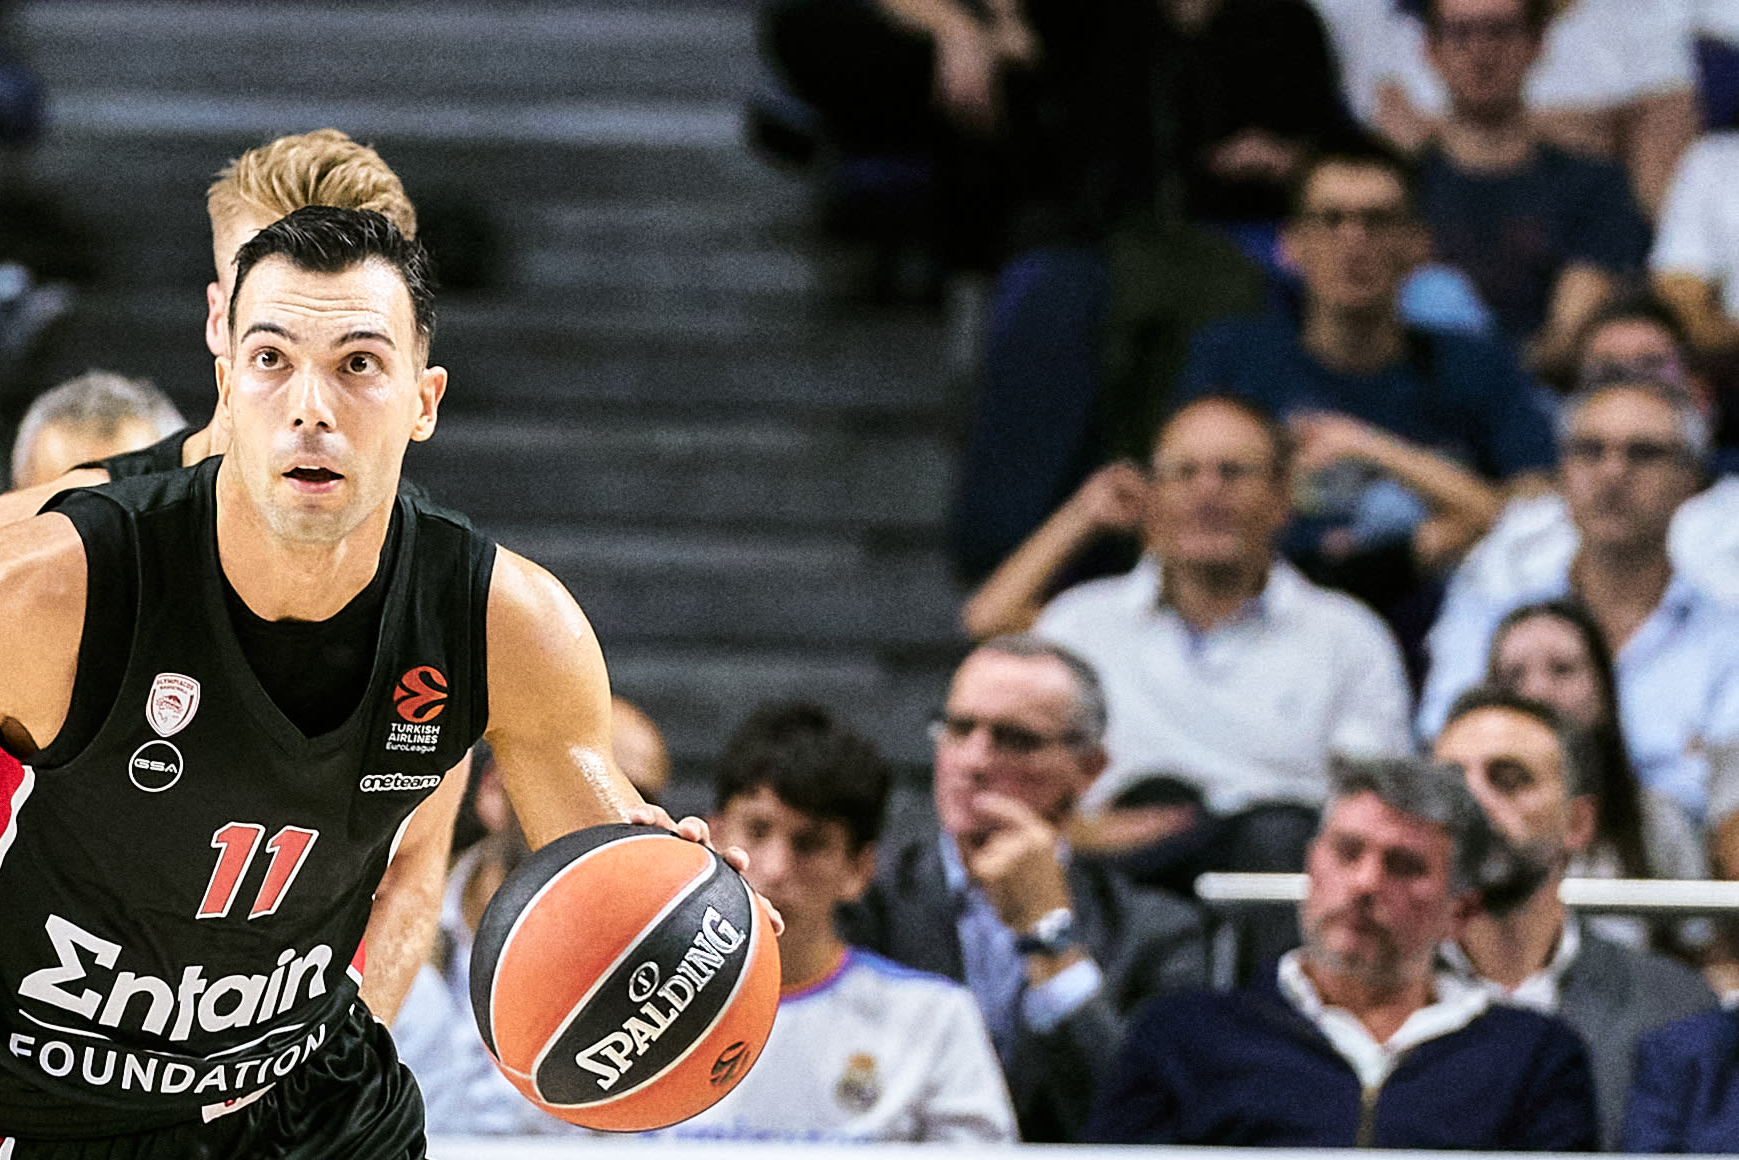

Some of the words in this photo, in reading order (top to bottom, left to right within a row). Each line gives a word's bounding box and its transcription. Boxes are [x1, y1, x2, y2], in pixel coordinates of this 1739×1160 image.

[388, 732, 438, 744] AIRLINES
[391, 722, 441, 735] TURKISH
[134, 758, 178, 774] GSA
[195, 821, 320, 920] 11
[575, 905, 746, 1091] SPALDING
[9, 1023, 326, 1094] FOUNDATION
